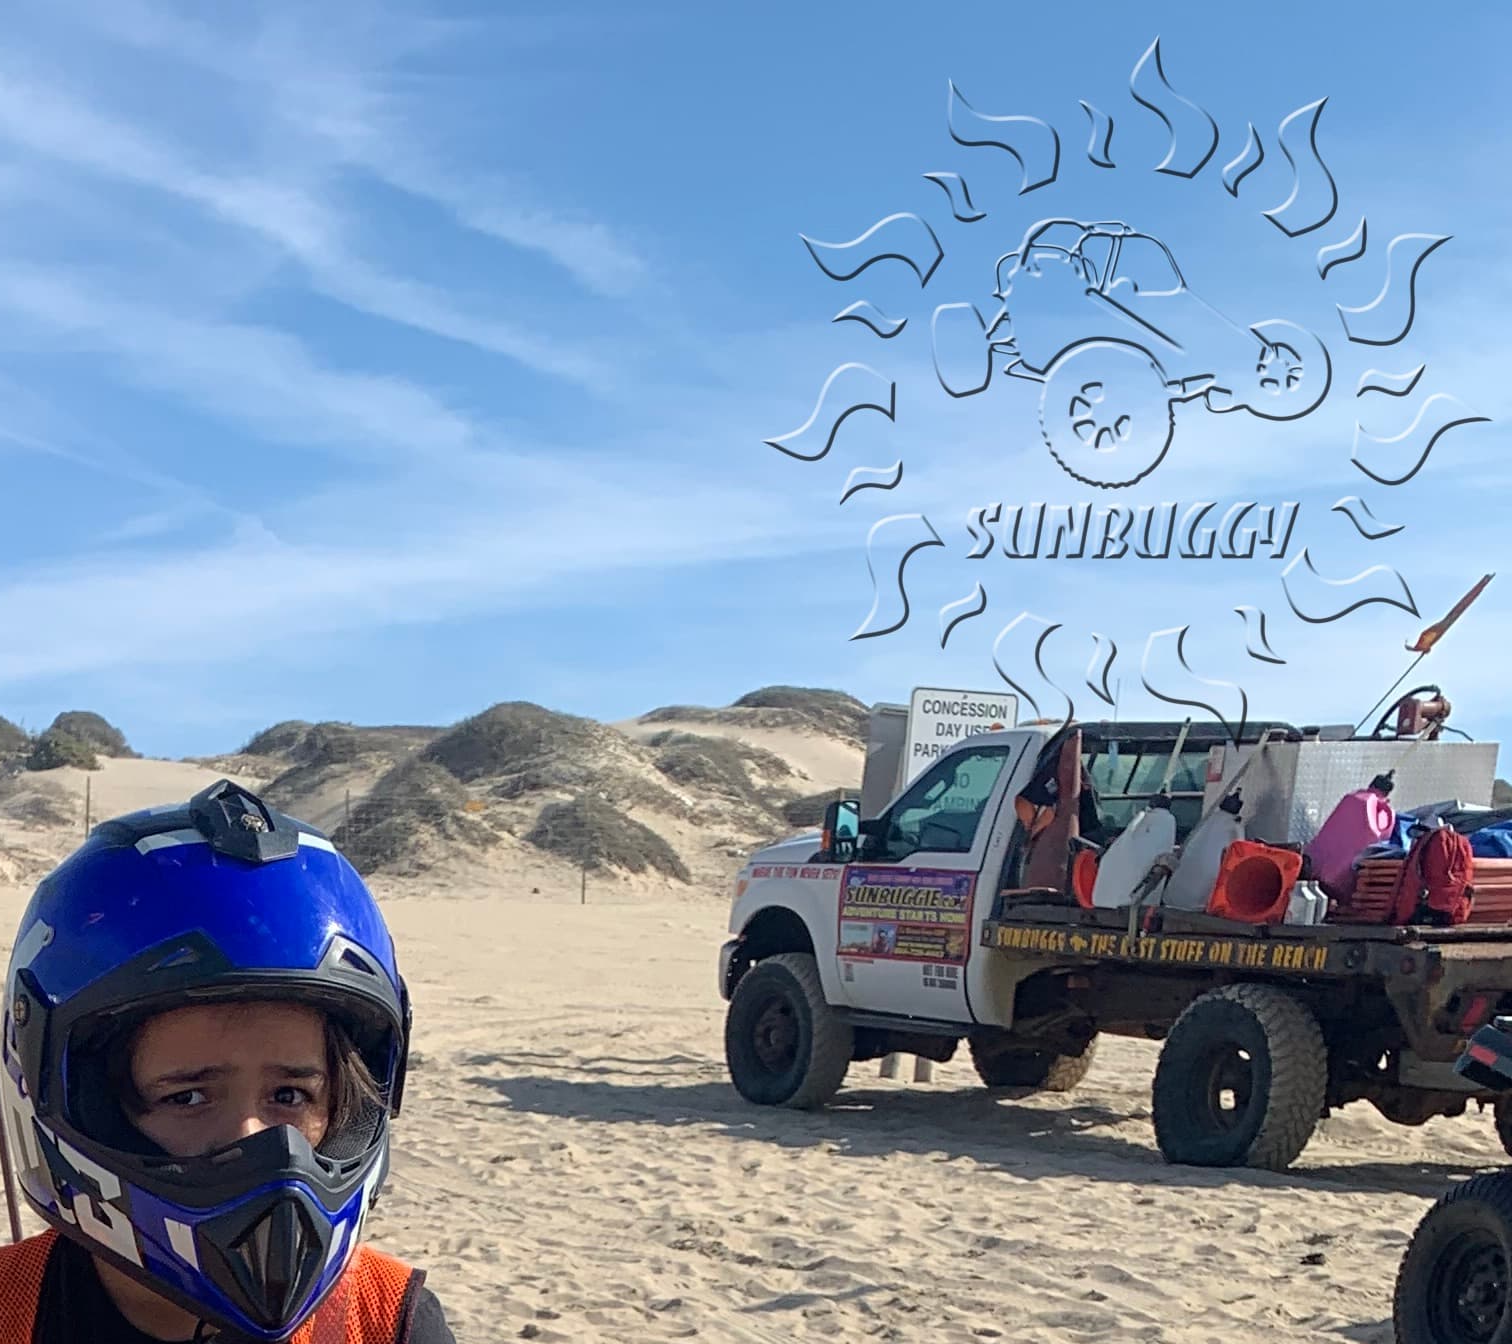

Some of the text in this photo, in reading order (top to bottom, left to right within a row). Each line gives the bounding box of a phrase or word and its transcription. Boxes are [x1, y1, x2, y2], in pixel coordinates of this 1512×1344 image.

[922, 699, 1007, 719] CONCESSION
[935, 722, 962, 737] DAY
[1090, 933, 1118, 956] THE
[1160, 938, 1206, 962] STUFF
[1208, 940, 1234, 965] ON
[1237, 943, 1267, 968] THE
